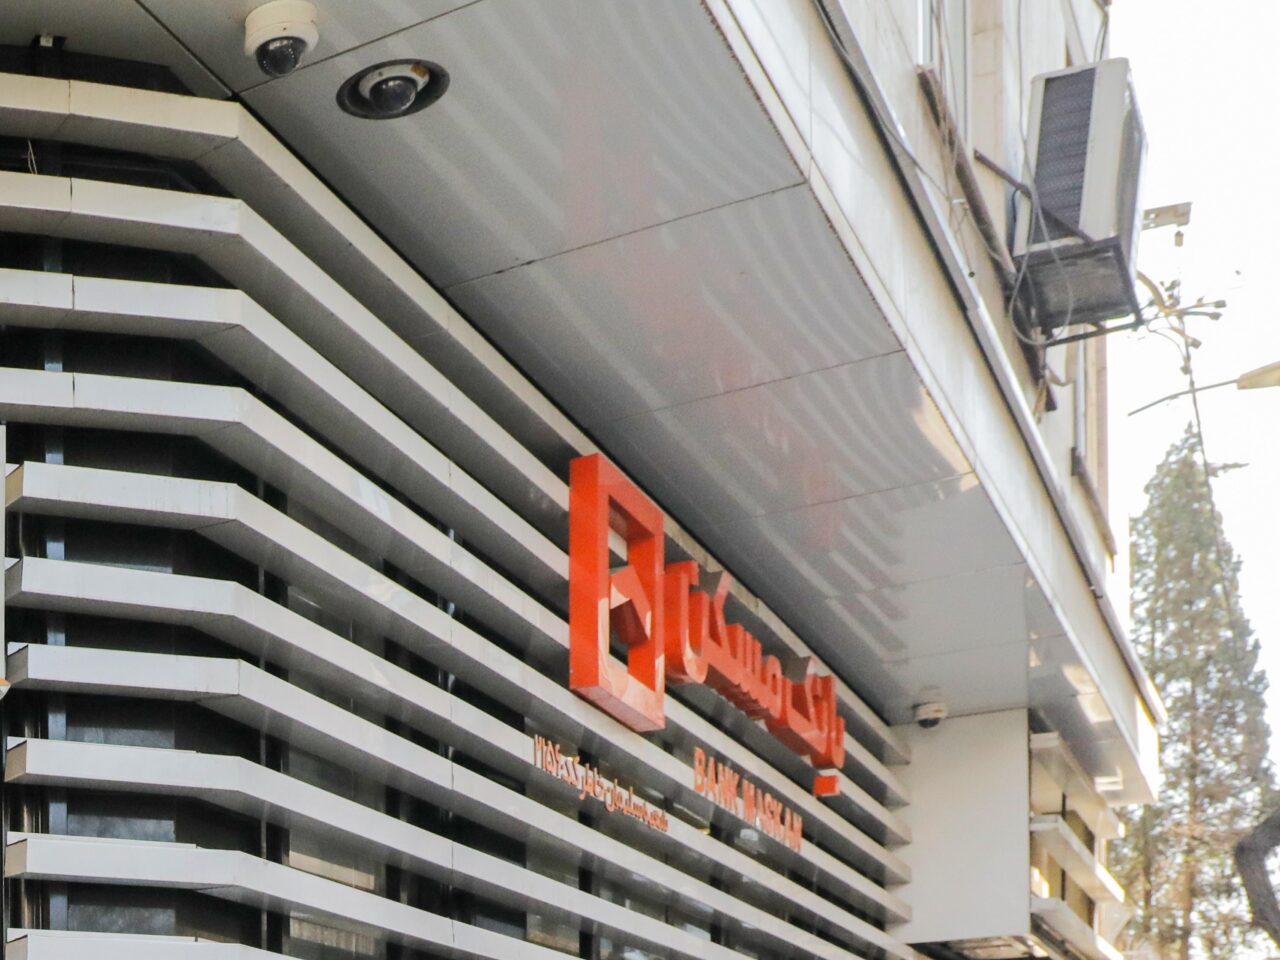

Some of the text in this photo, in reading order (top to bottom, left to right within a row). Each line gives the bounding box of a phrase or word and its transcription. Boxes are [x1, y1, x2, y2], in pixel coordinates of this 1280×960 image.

[780, 656, 845, 796] بانک
[694, 746, 804, 852] BANK MASKAN
